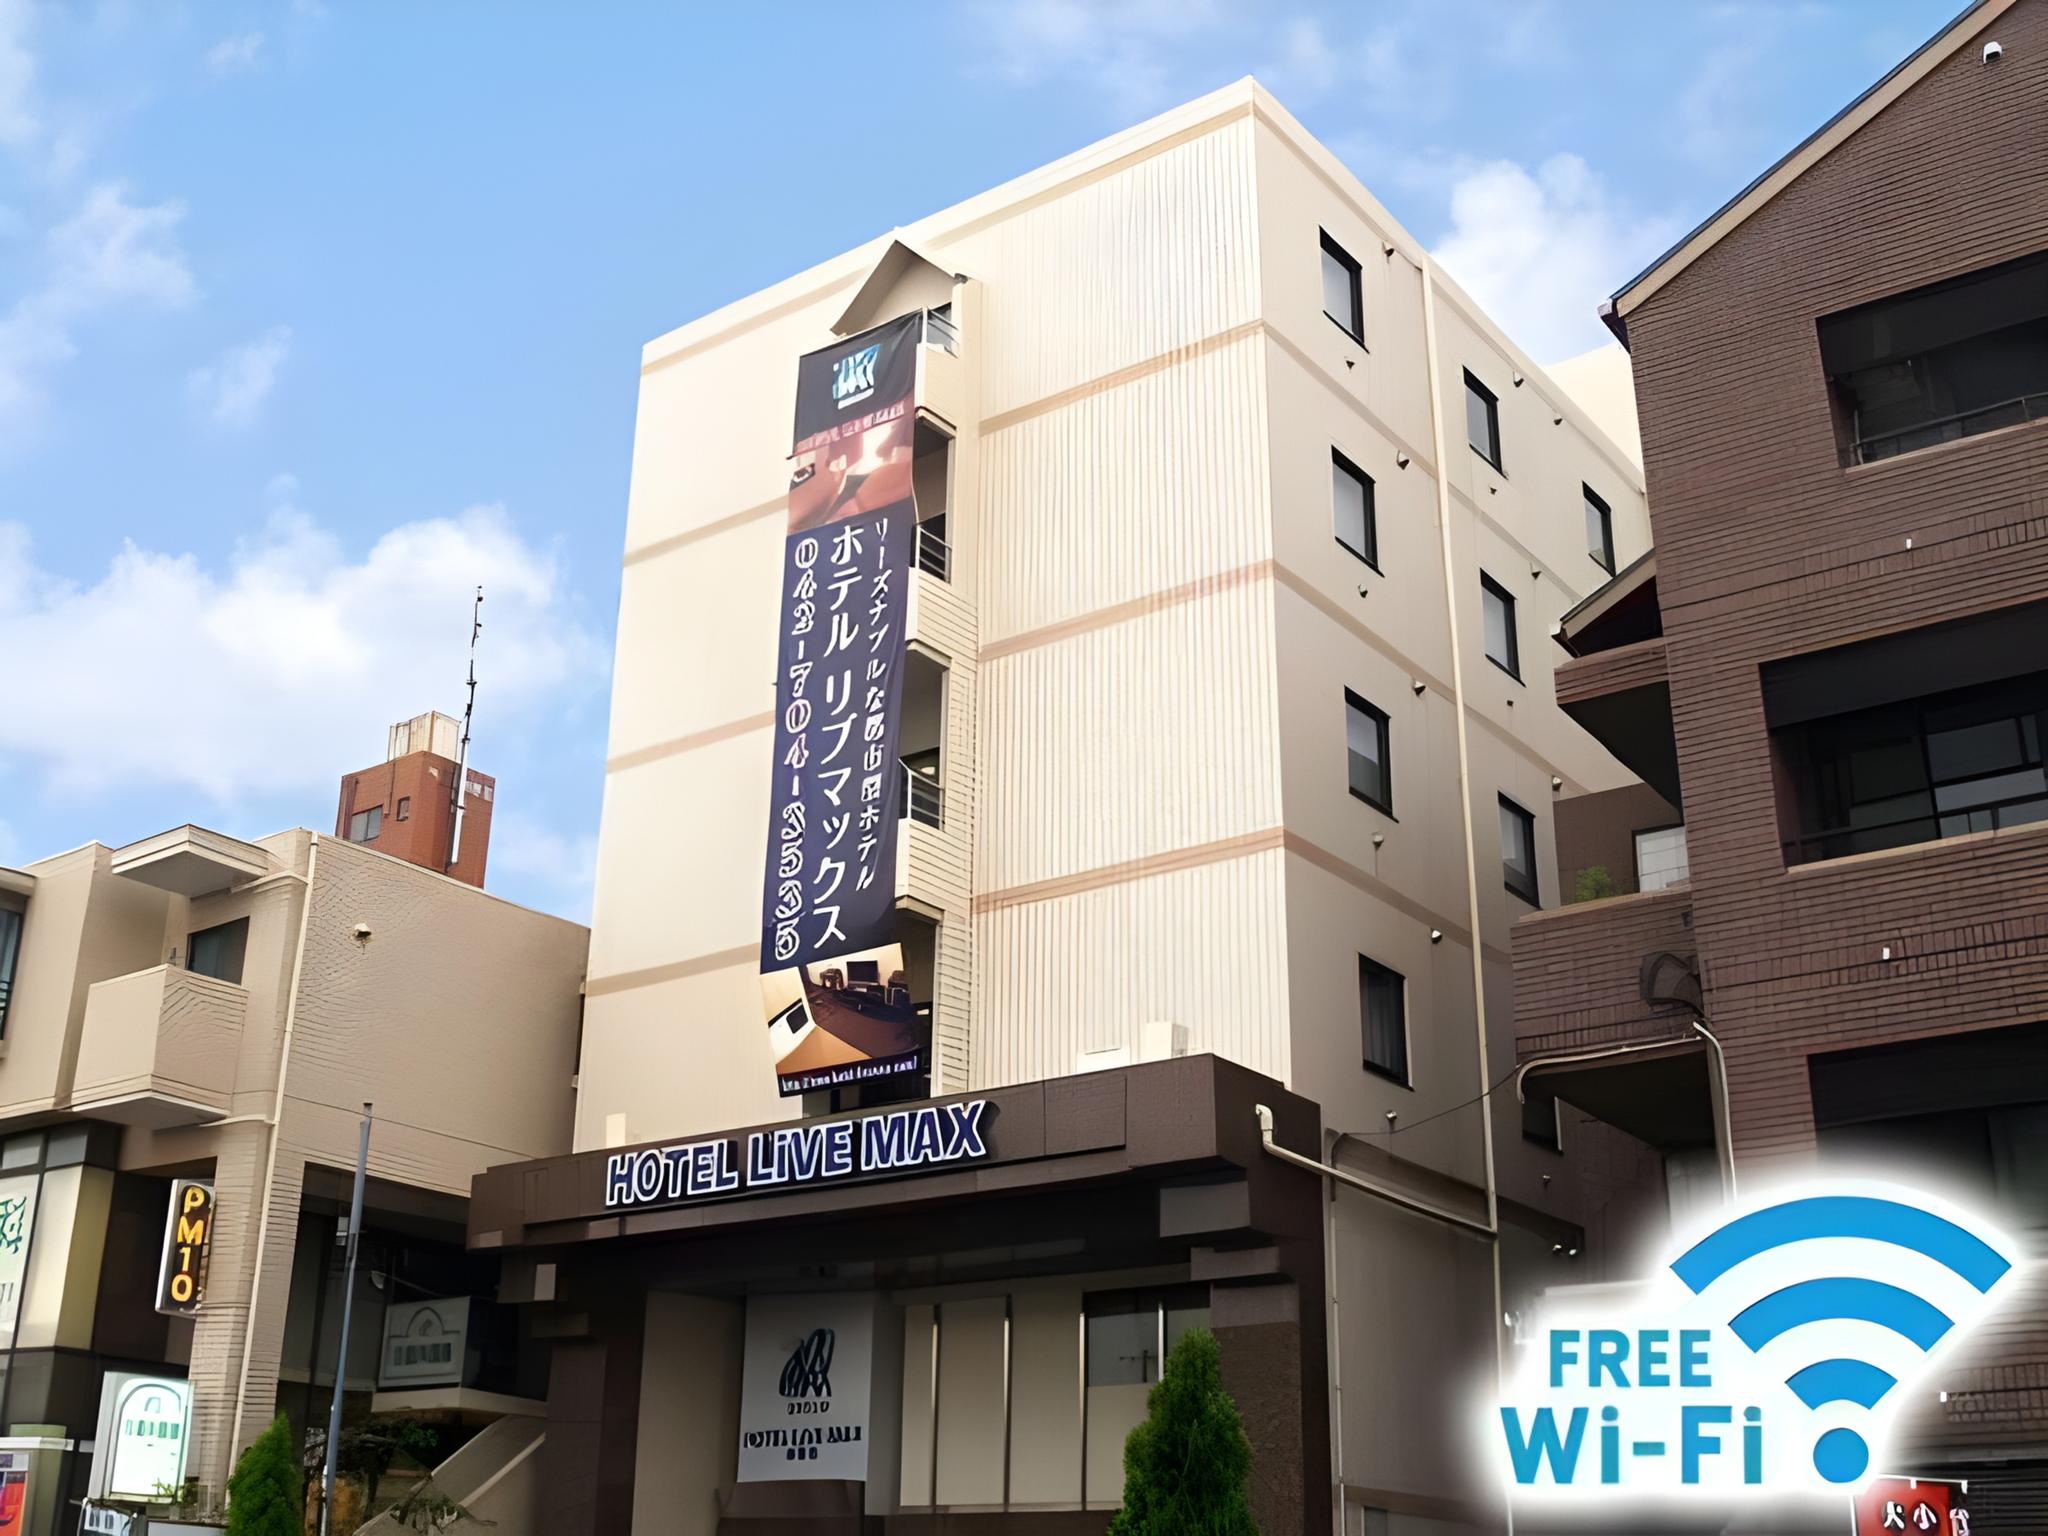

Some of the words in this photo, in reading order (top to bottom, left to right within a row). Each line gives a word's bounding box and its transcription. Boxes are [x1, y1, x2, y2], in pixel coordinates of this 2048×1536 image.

[606, 1139, 738, 1207] HOTEL
[747, 1120, 853, 1186] LiVE
[861, 1100, 987, 1172] MAX
